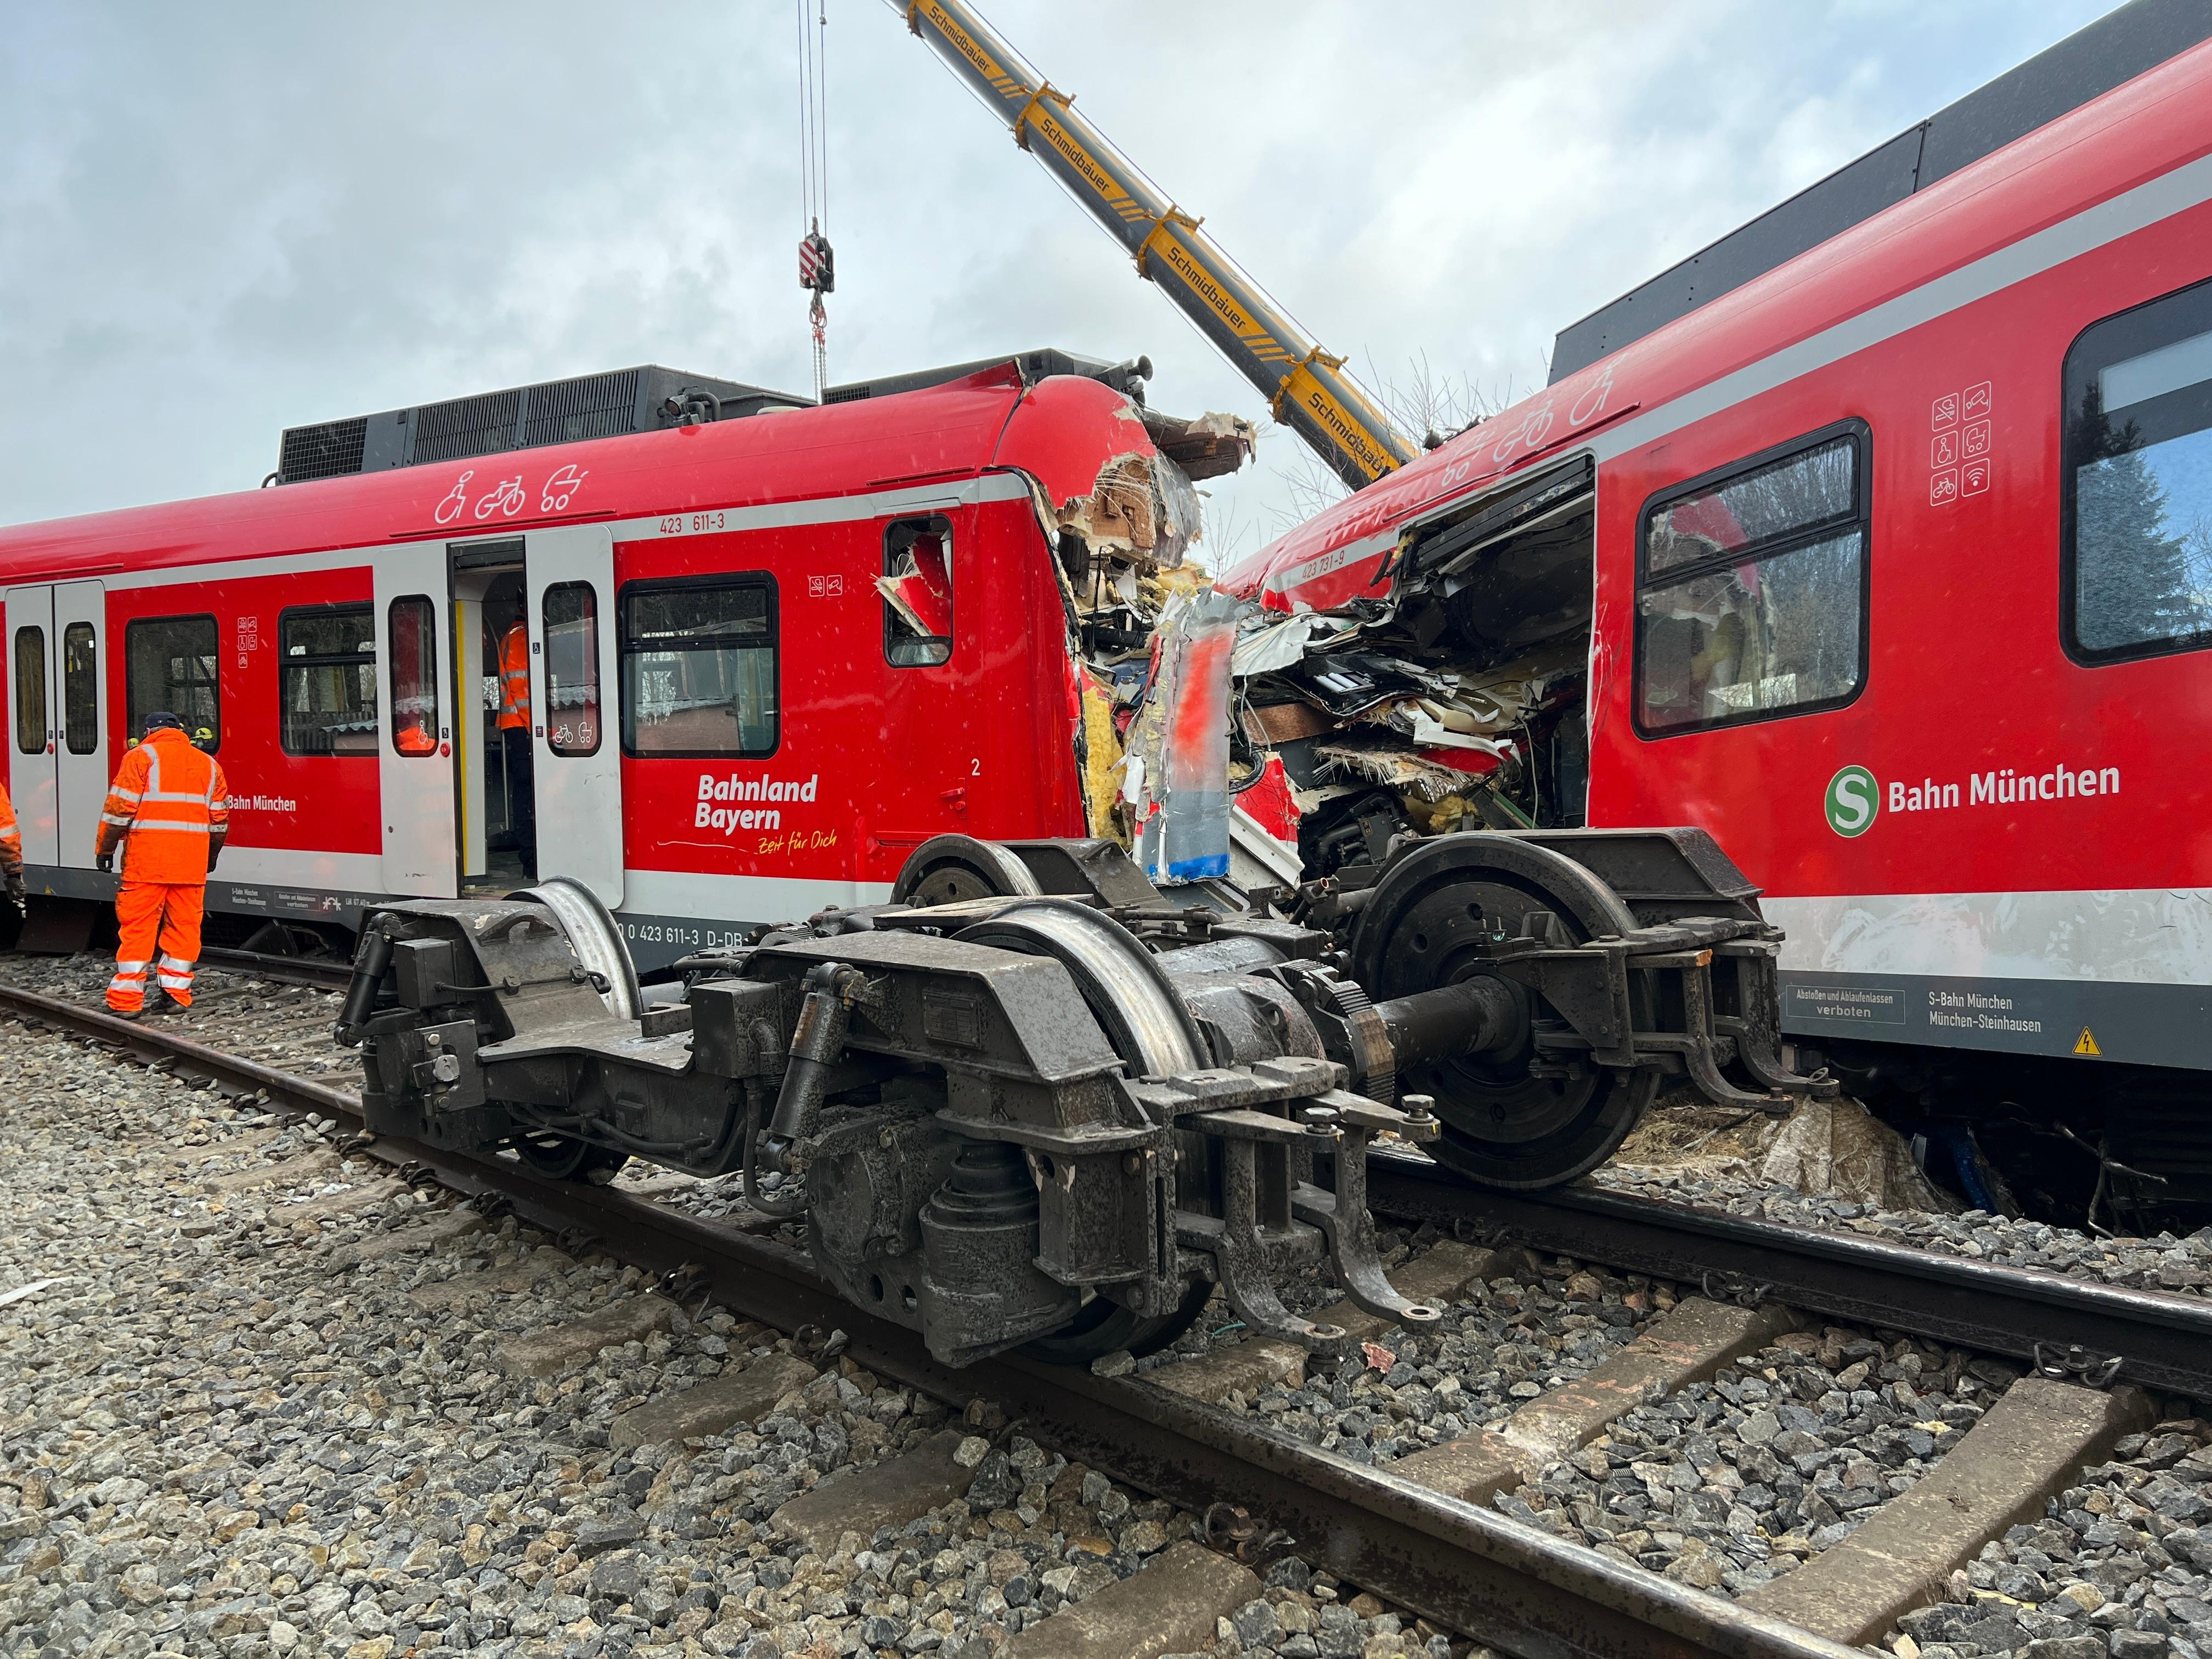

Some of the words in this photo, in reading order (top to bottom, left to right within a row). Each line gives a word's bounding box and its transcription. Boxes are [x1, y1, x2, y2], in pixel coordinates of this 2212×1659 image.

[929, 6, 990, 71] Schmidbauer
[1041, 118, 1109, 191] Schmidbauer
[1167, 247, 1246, 329] Schmidbauer
[1308, 392, 1384, 472] Schmidbau
[660, 517, 681, 534] 423
[693, 513, 724, 531] 611-3
[1302, 562, 1317, 579] 423
[1319, 550, 1344, 573] 731-9
[971, 758, 980, 776] 2
[698, 774, 818, 802] Bahnland
[1888, 778, 1959, 812] Bahn
[1970, 763, 2120, 805] München
[228, 794, 251, 810] Bahn
[253, 795, 296, 811] München
[695, 802, 780, 836] Bayern
[758, 834, 785, 854] Zeit
[788, 831, 808, 856] für
[811, 829, 837, 849] Dich
[628, 924, 635, 939] 0
[640, 925, 662, 942] 423
[666, 927, 699, 945] 611-3
[707, 930, 742, 947] D-DB
[1797, 989, 1826, 1001] Abstoßen
[1827, 992, 1839, 1002] und
[1840, 992, 1893, 1005] Ablaufenlassen
[1929, 991, 1964, 1008] S-Bahn
[1967, 993, 2012, 1010] München
[1816, 1006, 1871, 1018] verboten
[1929, 1011, 2041, 1032] München-Steinhausen
